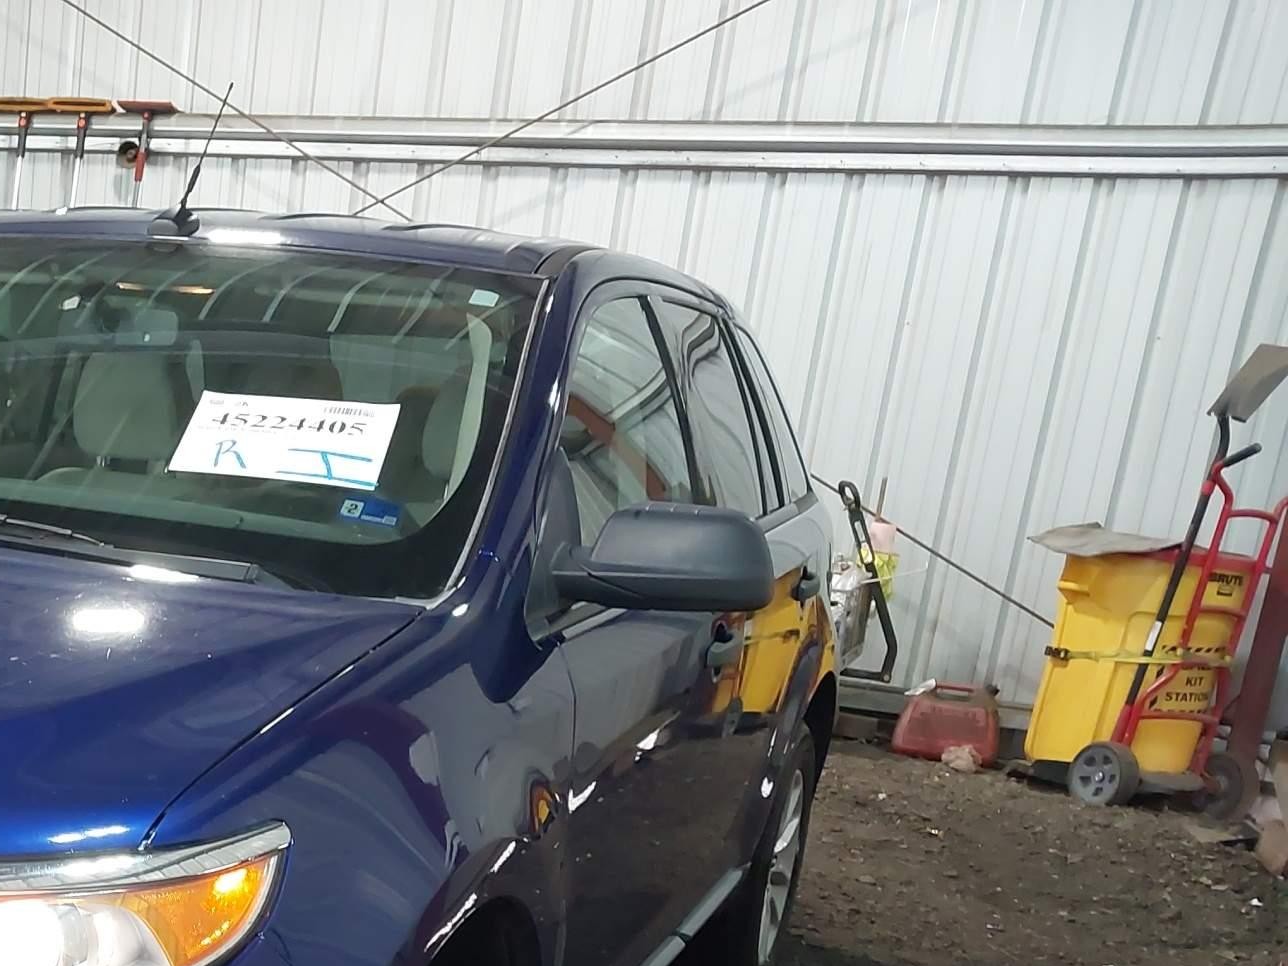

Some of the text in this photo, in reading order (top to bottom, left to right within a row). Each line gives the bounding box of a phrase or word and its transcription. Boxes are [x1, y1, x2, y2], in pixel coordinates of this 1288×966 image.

[211, 412, 367, 436] 45224405
[213, 439, 247, 469] R
[1185, 676, 1204, 687] KIT
